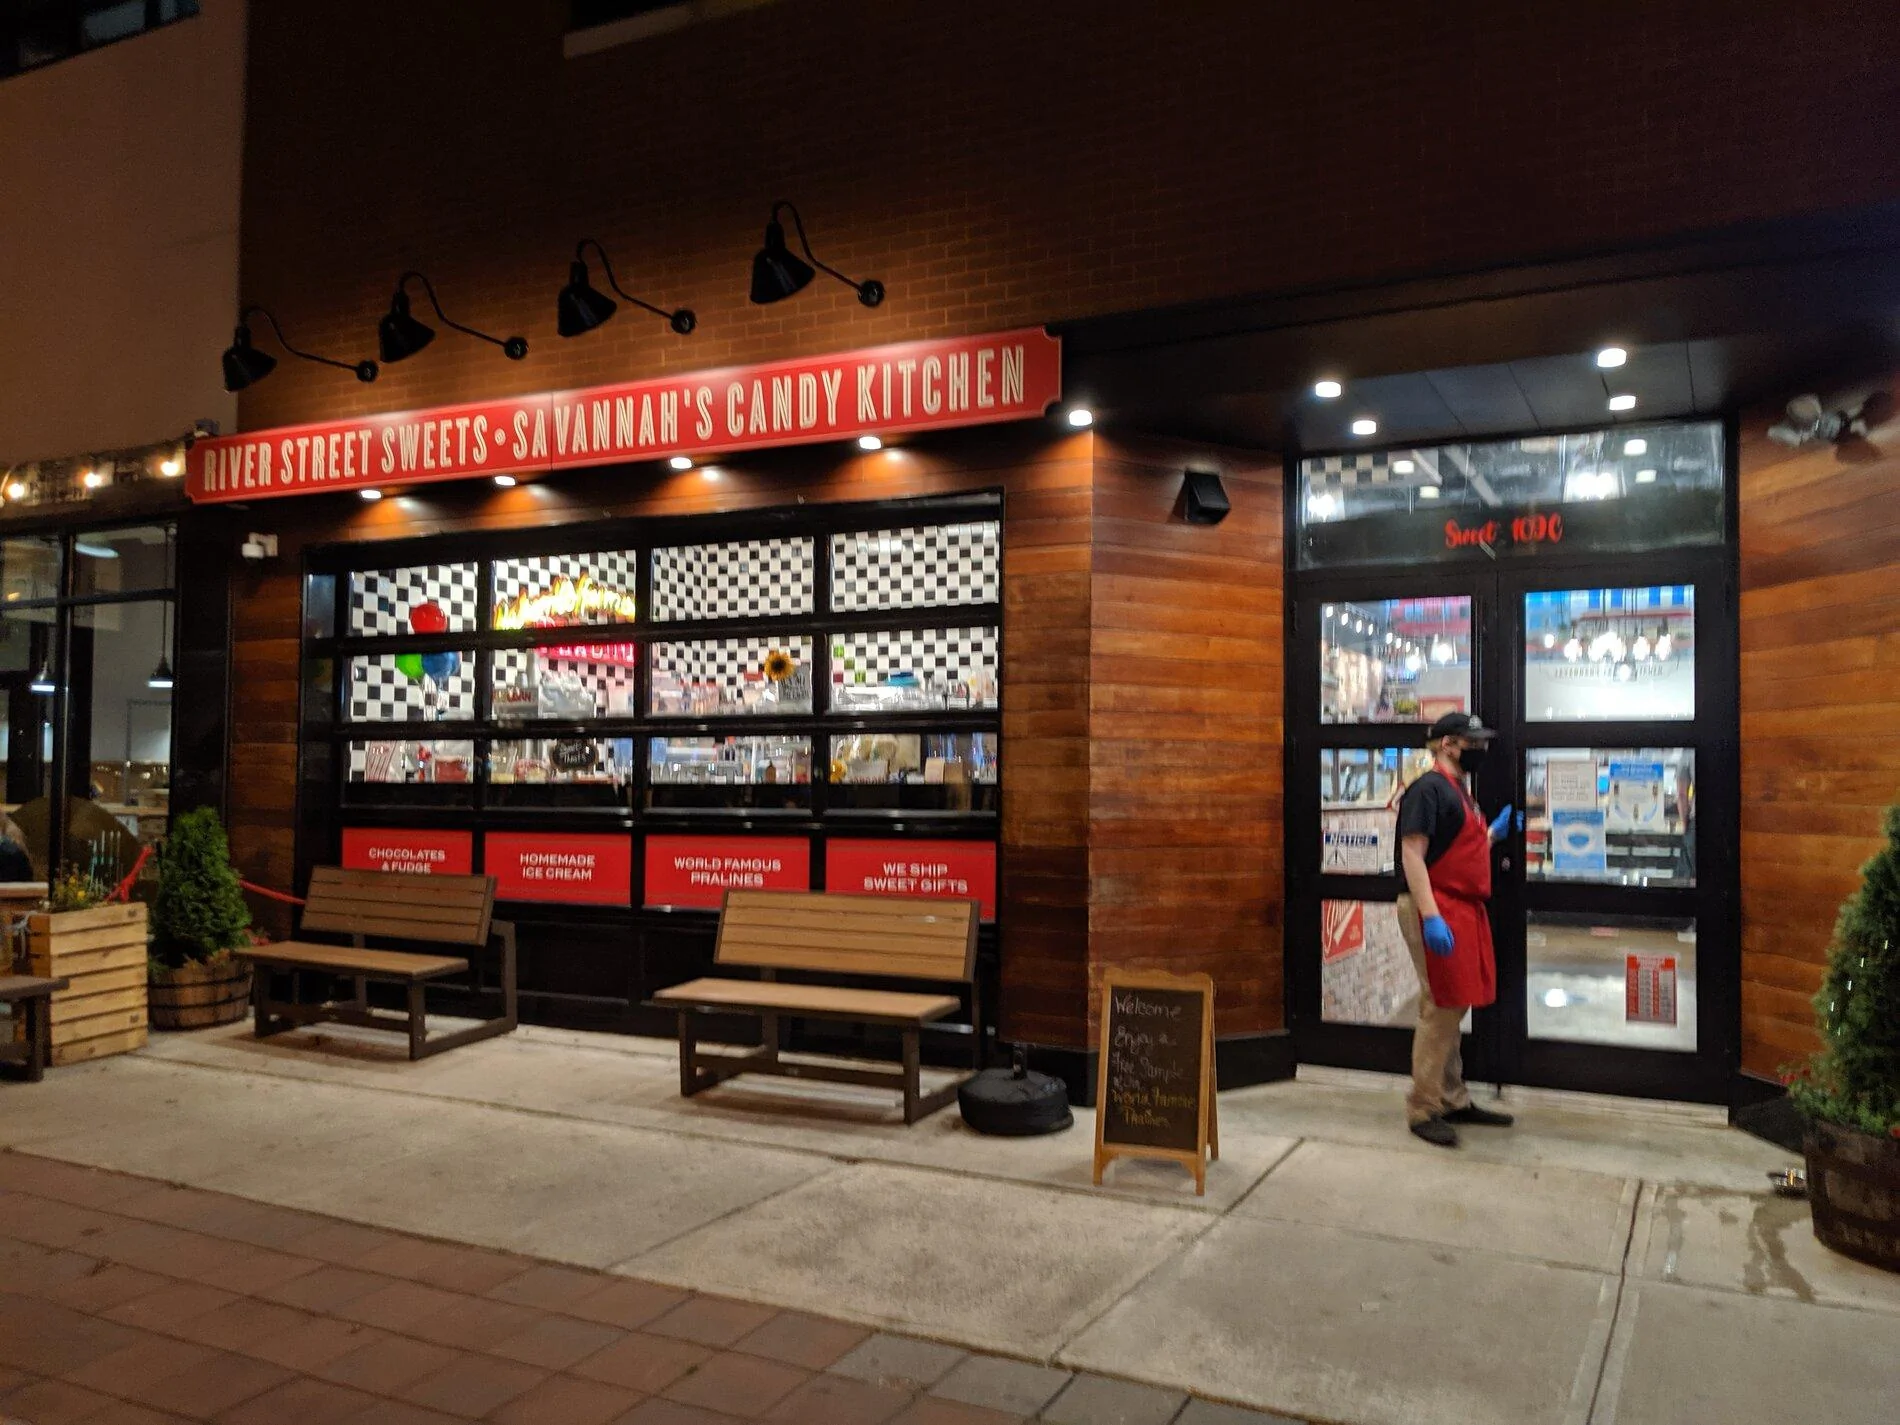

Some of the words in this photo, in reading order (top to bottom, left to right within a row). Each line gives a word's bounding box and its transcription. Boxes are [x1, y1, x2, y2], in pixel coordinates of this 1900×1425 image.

[204, 442, 271, 492] RIVER
[280, 429, 373, 485] STREET
[381, 414, 488, 473] SWEETS
[512, 386, 713, 460] SAVANNAH'S
[726, 368, 842, 437] CANDY
[857, 345, 1025, 424] KITCHEN
[368, 847, 445, 861] CHOCOLATES
[520, 853, 595, 867] HOMEMADE
[381, 861, 389, 871] &
[391, 861, 431, 874] FUDGE
[674, 856, 722, 870] WORLD
[724, 858, 781, 872] FAMOUS
[883, 862, 906, 877] WE
[909, 863, 947, 877] SHIP
[522, 866, 542, 879] ICE
[545, 867, 592, 881] CREAM
[691, 871, 764, 887] PRALINES
[864, 876, 917, 891] SWEET
[920, 877, 968, 893] GIFTS
[1115, 993, 1182, 1018] Welcome
